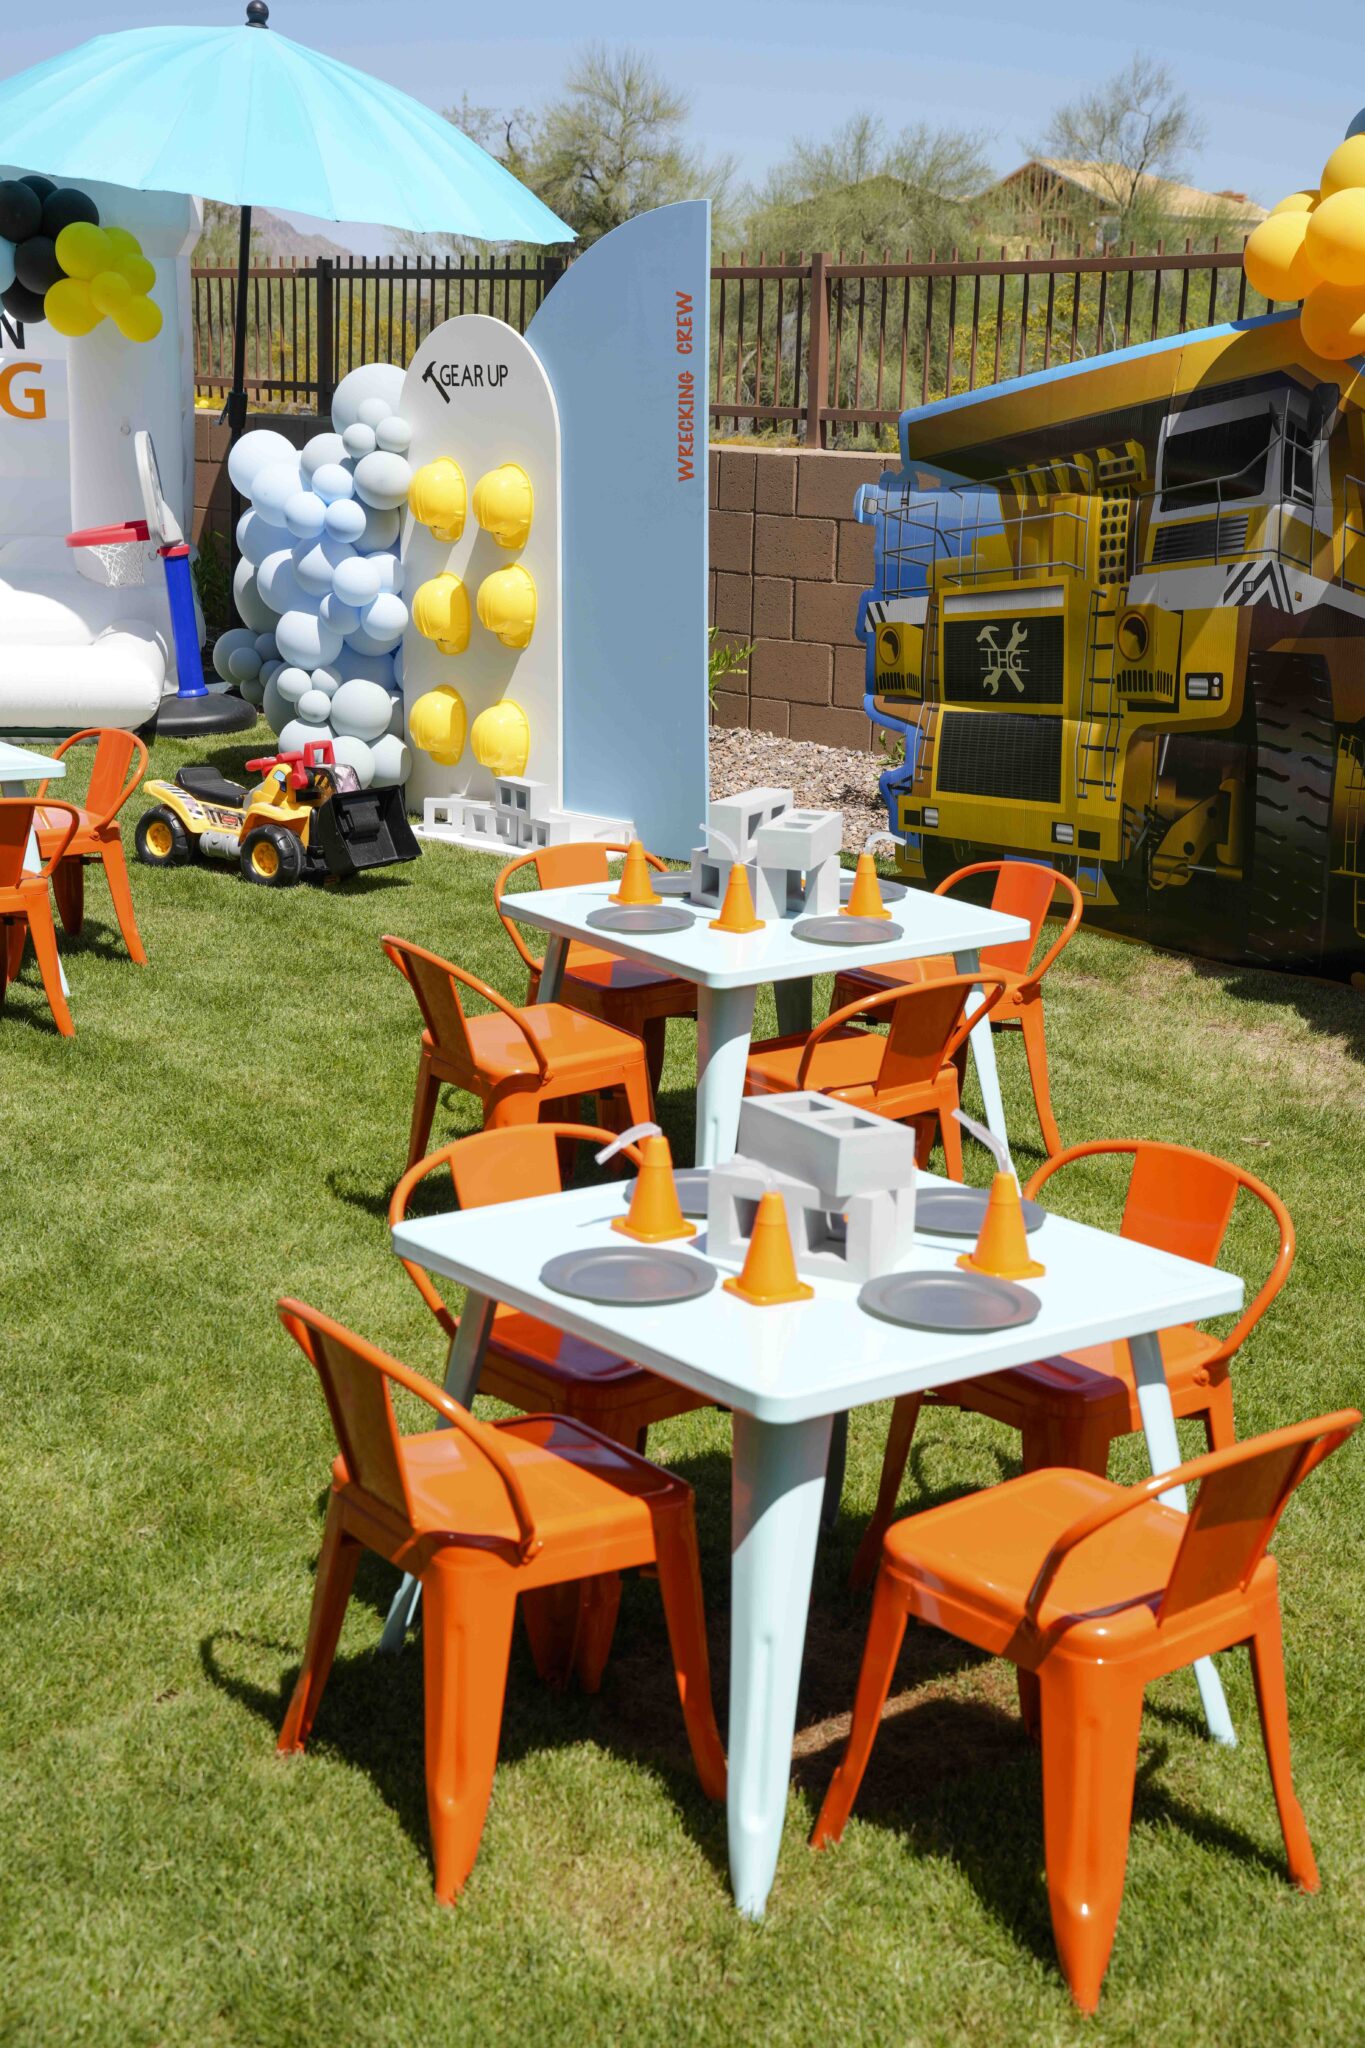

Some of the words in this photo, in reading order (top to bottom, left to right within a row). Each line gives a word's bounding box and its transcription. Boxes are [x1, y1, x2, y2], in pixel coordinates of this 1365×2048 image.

[675, 290, 694, 355] CREW
[440, 364, 485, 387] GEAR
[487, 364, 509, 388] UP
[676, 370, 696, 483] WRECKING
